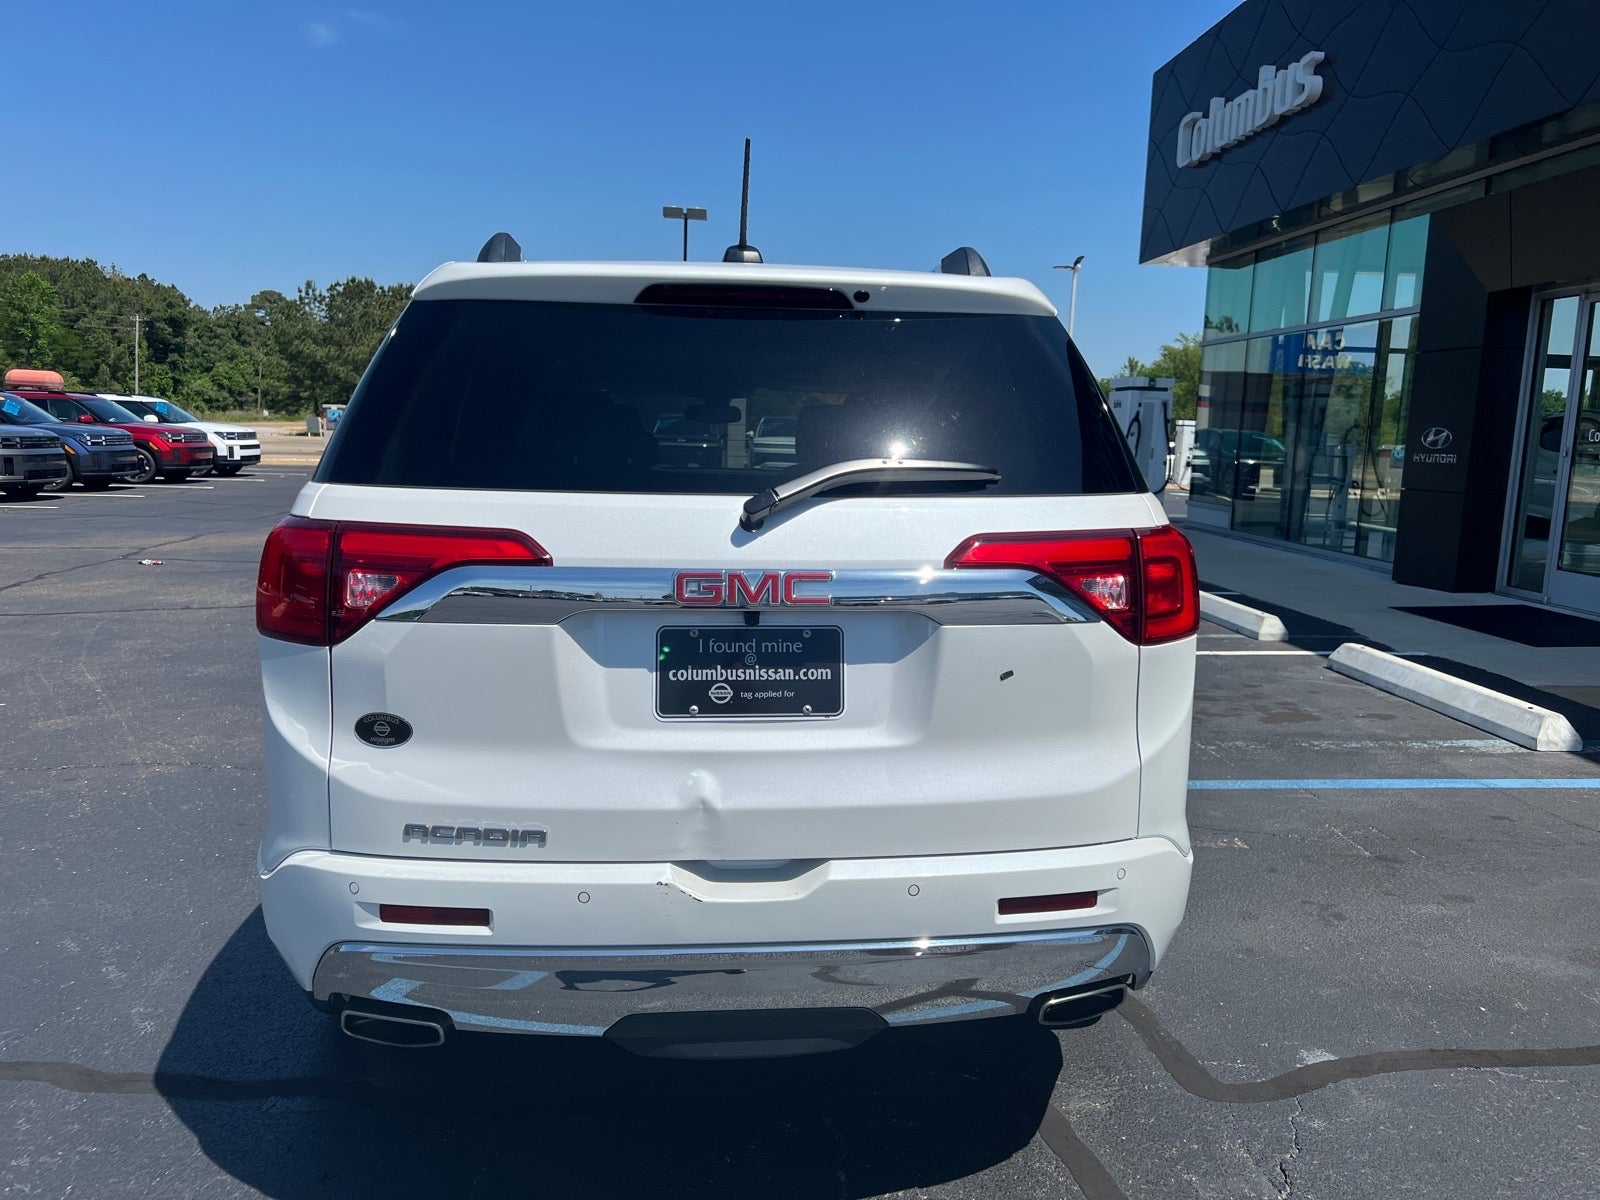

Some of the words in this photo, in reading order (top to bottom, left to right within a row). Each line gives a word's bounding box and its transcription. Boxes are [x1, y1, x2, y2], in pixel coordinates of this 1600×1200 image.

[1176, 51, 1325, 168] Columbus
[1412, 453, 1457, 464] HYUNDAI
[674, 570, 834, 605] GMC
[699, 639, 703, 653] I
[709, 638, 756, 653] found
[761, 639, 803, 653] mine
[744, 653, 757, 666] @
[668, 665, 832, 681] columbusnissan.com
[709, 689, 733, 697] NISSAN
[740, 691, 753, 699] tag
[754, 690, 782, 699] applied
[363, 714, 400, 725] COLUMBUS
[402, 823, 548, 848] ACADIA
